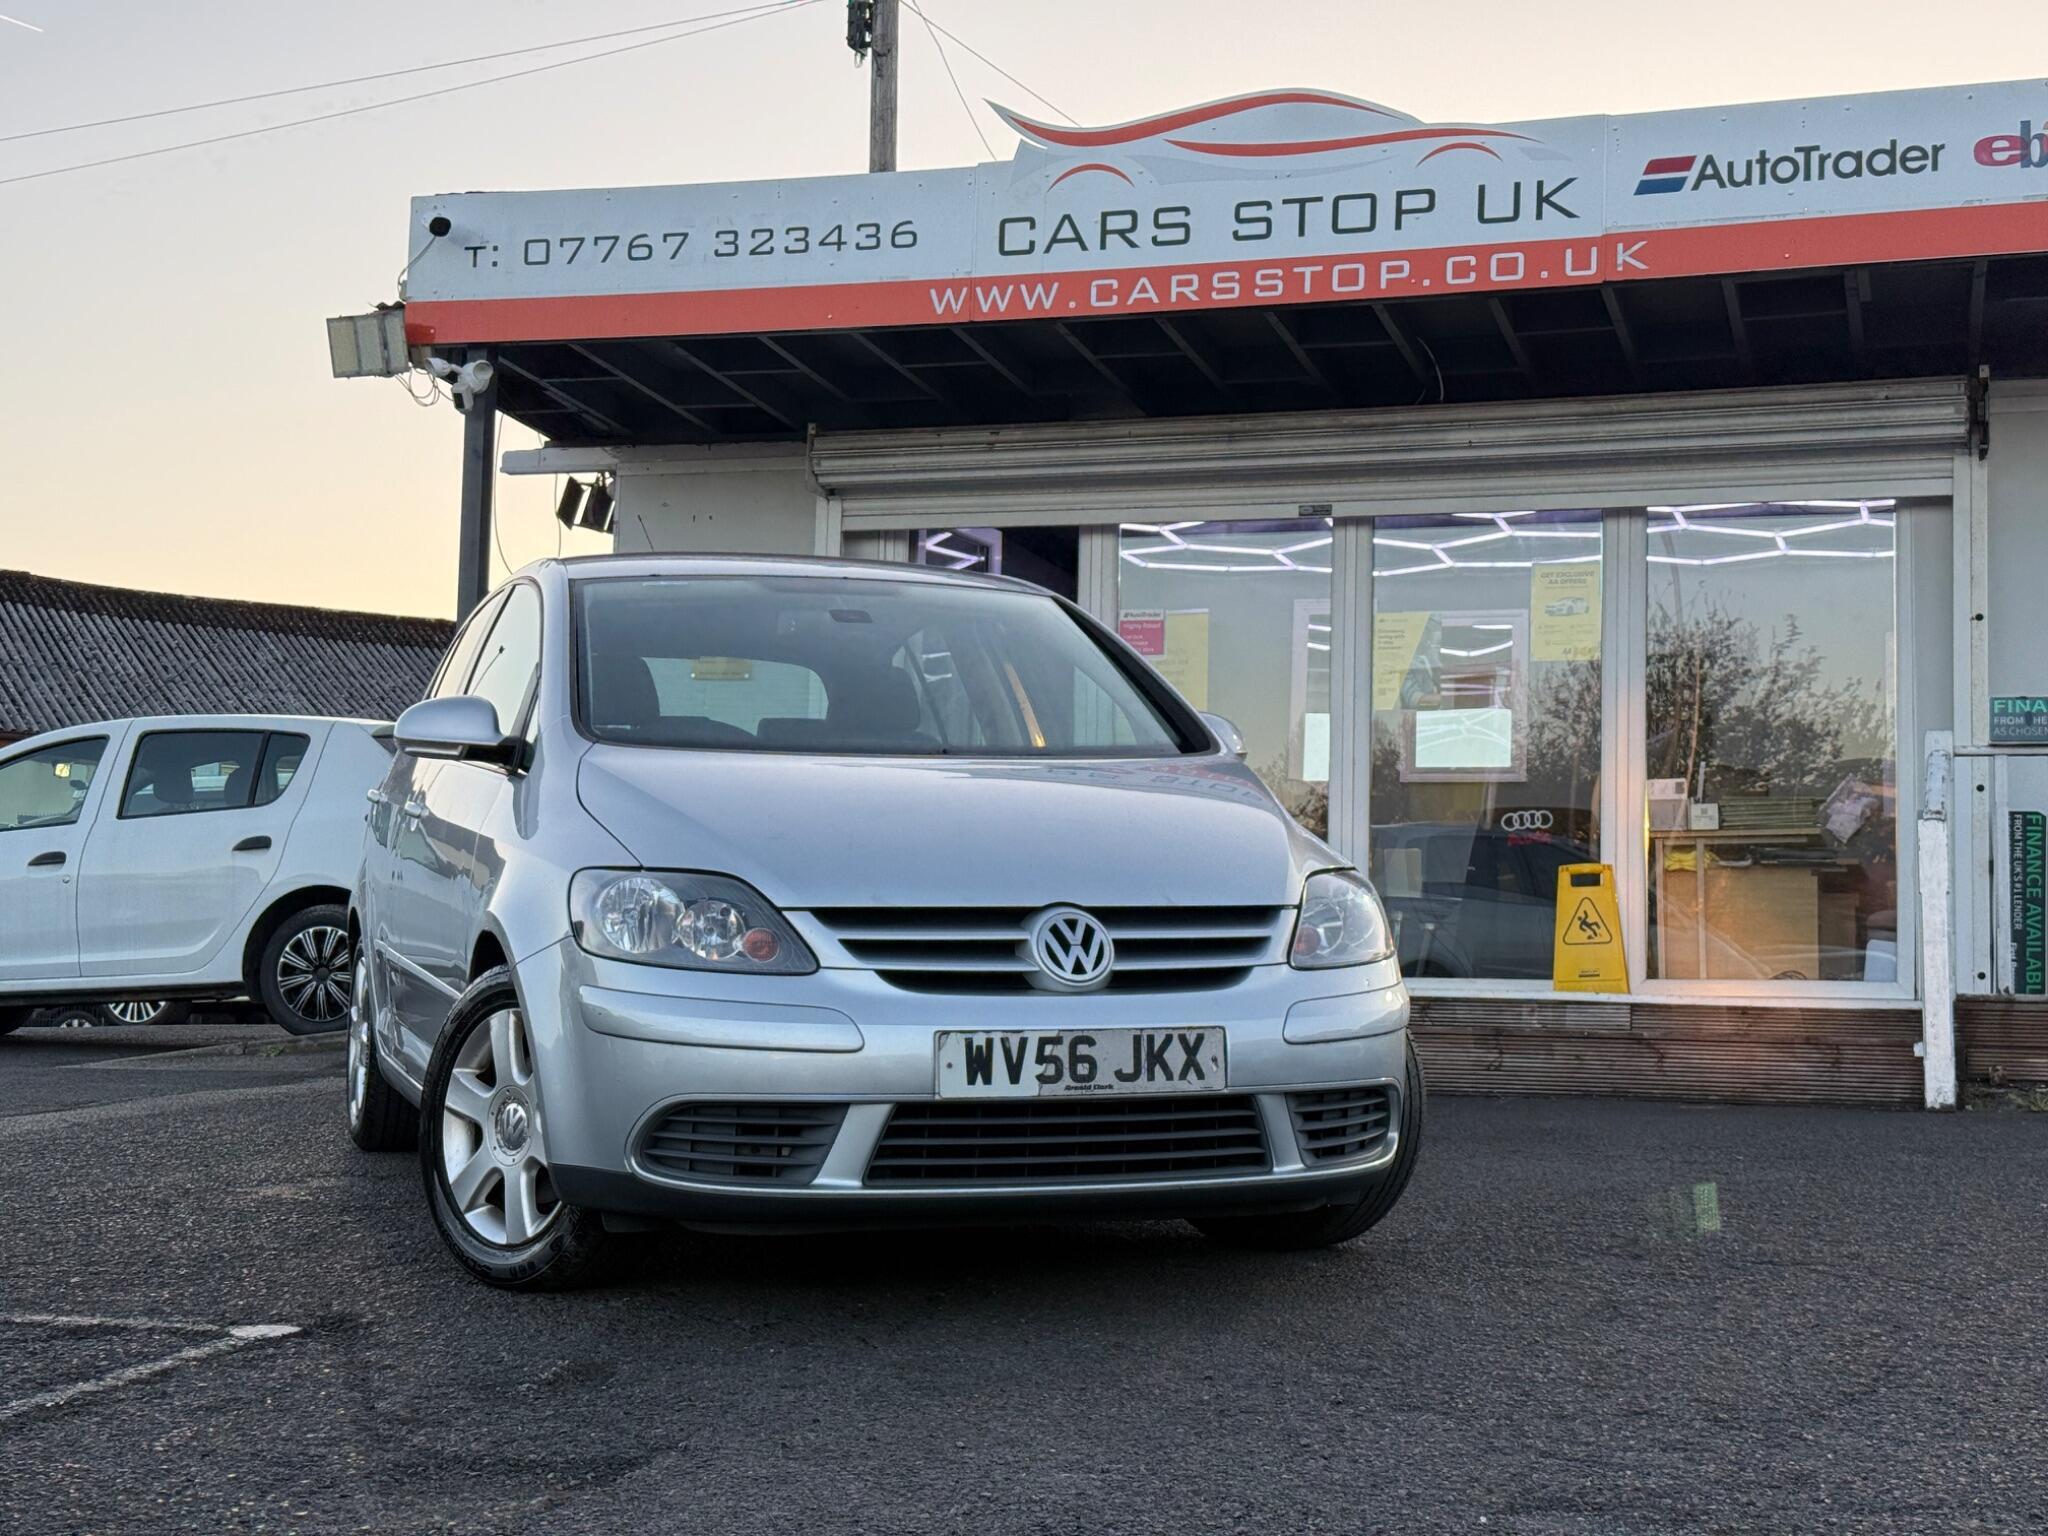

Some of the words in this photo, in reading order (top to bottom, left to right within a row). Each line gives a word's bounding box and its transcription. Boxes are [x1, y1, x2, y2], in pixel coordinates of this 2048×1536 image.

[1690, 139, 1946, 192] AutoTrader
[1973, 120, 2048, 169] eb
[999, 205, 1193, 257] CARS
[1231, 187, 1437, 242] STOP
[1476, 177, 1581, 225] UK
[465, 245, 499, 269] T:
[522, 232, 690, 267] 07767
[713, 219, 920, 259] 323436
[929, 240, 1650, 316] WWW.CARSSTOP.CO.UK
[1993, 716, 2024, 726] FROM
[2013, 814, 2023, 839] FROM
[2013, 842, 2023, 859] THE
[2026, 814, 2042, 898] FINANCE
[2013, 895, 2023, 930] LENDER
[964, 1034, 1098, 1086] WV56
[1114, 1032, 1206, 1084] JKX
